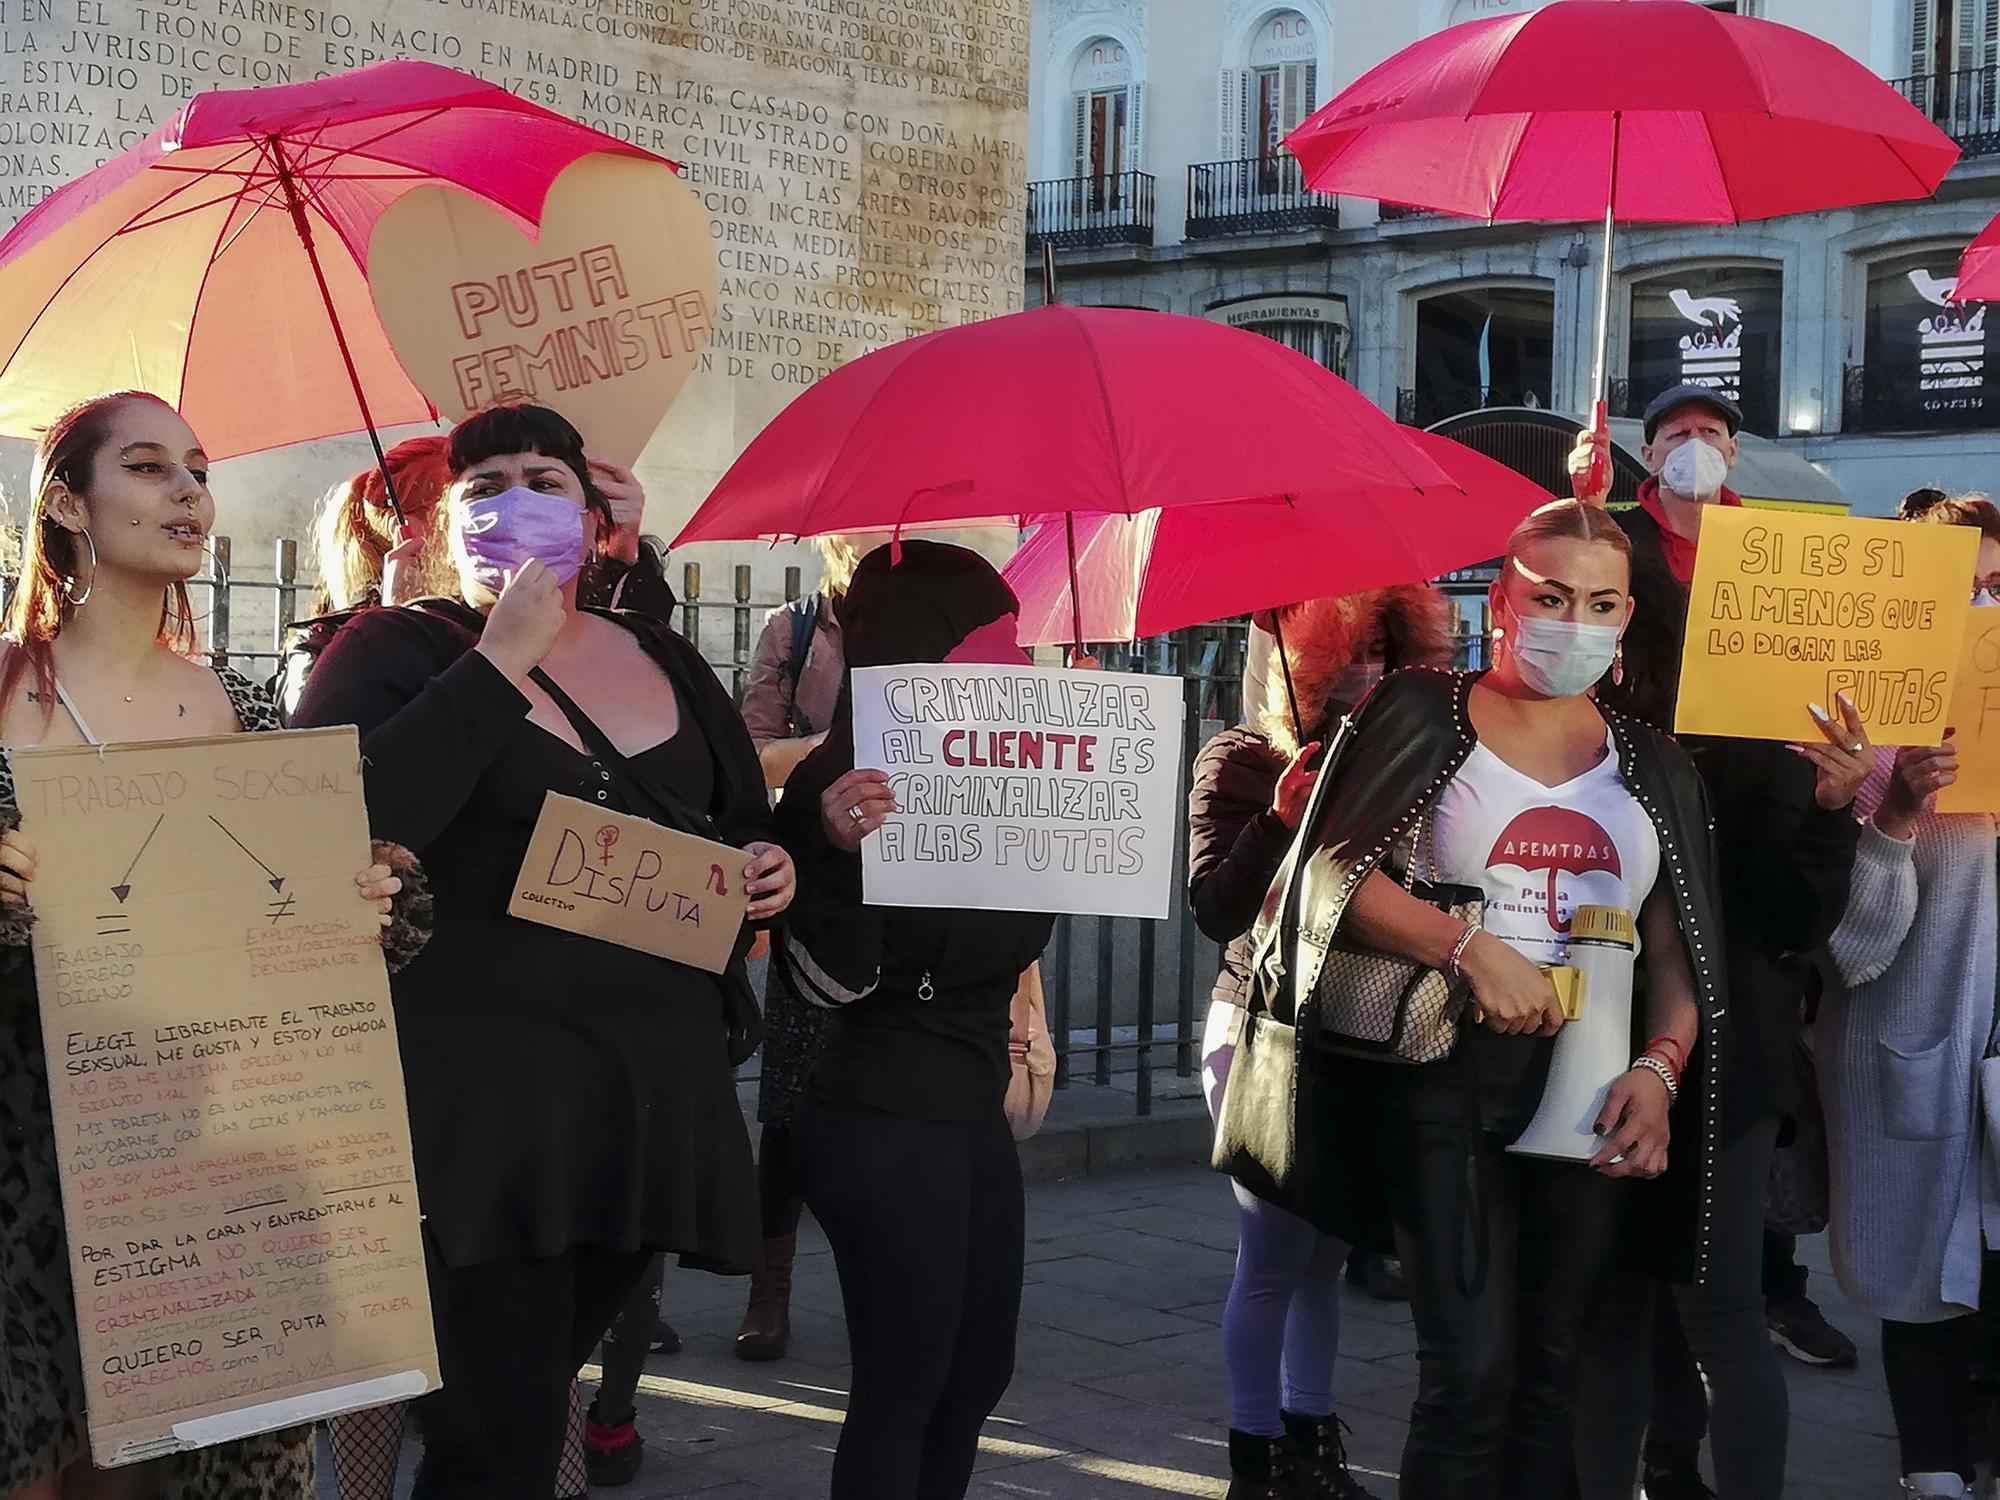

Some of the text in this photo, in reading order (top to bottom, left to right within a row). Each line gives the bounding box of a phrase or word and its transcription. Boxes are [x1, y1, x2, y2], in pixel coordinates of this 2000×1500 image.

[76, 0, 303, 60] EL TRONO DE
[786, 29, 815, 50] SAN
[820, 36, 883, 63] CARLOS
[890, 49, 908, 69] DE
[839, 19, 924, 51] POBLACION
[930, 36, 946, 56] EN
[3, 30, 293, 85] LA JVRISDICCION
[22, 59, 195, 99] ESTVDIO DE
[370, 20, 462, 59] NACIO
[480, 41, 512, 68] EN
[526, 50, 619, 88] MADRID
[635, 70, 663, 95] EN
[730, 88, 829, 126] CASADO
[843, 109, 890, 137] CON
[900, 119, 959, 151] DOÑA
[930, 77, 969, 101] BAJA
[114, 96, 156, 126] LA
[582, 90, 977, 177] MONARCA ILVSTRADO GOBERNO
[682, 134, 968, 202] CIVIL FRENTE A OTROS
[778, 175, 913, 218] Y LAS ARTES
[791, 231, 932, 272] MEDIANTE LA
[450, 244, 630, 340] PUTA
[793, 285, 949, 325] NACIONAL DEL
[451, 289, 712, 412] FEMINISTA
[727, 355, 756, 379] DE
[816, 340, 844, 363] DE
[1740, 526, 1905, 579] SI ES SI
[1711, 580, 1937, 631] A MENOS QUE
[1707, 628, 1883, 663] LO DIGAN LAS
[884, 676, 1156, 731] CRIMINALIZAR
[1826, 667, 1949, 727] PUTAS
[882, 729, 1155, 775] AL CLIENTE ES
[29, 759, 353, 819] TRABAJO SEXSUAL
[887, 771, 1142, 822] CRIMINALIZAR
[879, 821, 1146, 877] A LAS PUTAS
[1502, 839, 1612, 861] AFEMTRAS
[521, 889, 576, 912] COLECTIVO
[40, 942, 145, 970] TRABAJO
[54, 962, 136, 989] OBRERO
[55, 983, 133, 1008] DIGNO
[65, 1001, 377, 1056] ELEGI LIBREMENTE EL TRABAJO
[155, 1046, 185, 1067] ME
[192, 1039, 243, 1060] GUSTA
[248, 1036, 260, 1050] Y
[272, 1027, 323, 1047] ESTOY
[330, 1018, 388, 1039] COMODA
[68, 1080, 98, 1098] NO
[106, 1075, 128, 1093] ES
[299, 1047, 310, 1061] Y
[315, 1045, 337, 1058] NO
[75, 1120, 105, 1138] MI
[179, 1106, 202, 1123] NO
[208, 1102, 226, 1117] ES
[232, 1098, 257, 1113] UN
[346, 1079, 376, 1095] POR
[77, 1083, 222, 1115] SIENTO MAL AL
[172, 1126, 203, 1144] CON
[212, 1120, 241, 1137] LAS
[247, 1111, 291, 1131] CITAS
[368, 1096, 388, 1112] ES
[69, 1157, 98, 1176] UN
[82, 1198, 96, 1211] O
[207, 1170, 243, 1189] SIN
[335, 1151, 364, 1166] SER
[80, 1191, 405, 1264] POR DAR LA CARA Y ENFRENTARME AL
[84, 1213, 135, 1234] PERO
[92, 1225, 370, 1288] ESTIGMA NO QUIERO SER
[238, 1260, 269, 1282] NI
[361, 1235, 393, 1256] NI
[94, 1287, 258, 1335] CRIMINALIZADA
[101, 1338, 204, 1376] QUIERO
[221, 1326, 266, 1350] SER
[279, 1312, 329, 1339] PUTA
[359, 1295, 414, 1319] TENER
[102, 1357, 217, 1399] DERECHOS
